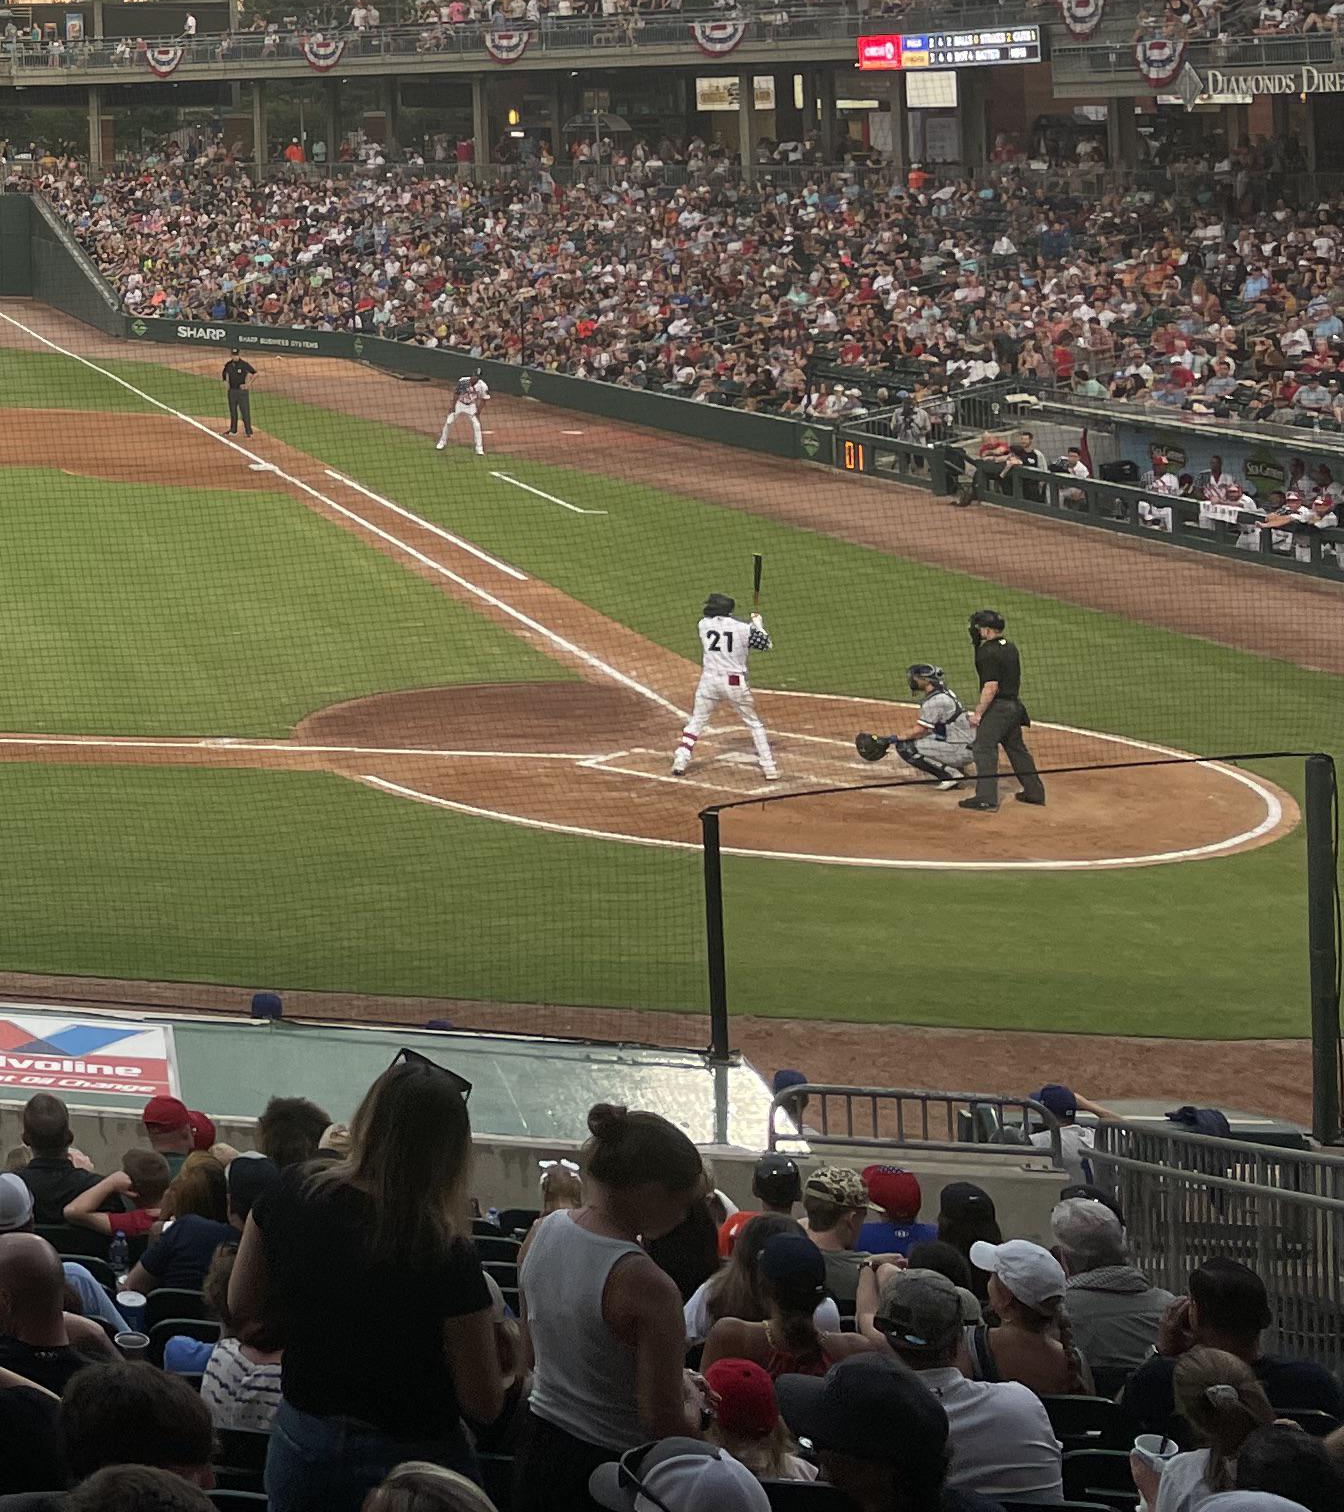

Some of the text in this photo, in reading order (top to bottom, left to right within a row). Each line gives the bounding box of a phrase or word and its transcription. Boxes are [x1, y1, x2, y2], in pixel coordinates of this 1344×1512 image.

[1208, 70, 1296, 95] DIAMONDS
[177, 326, 226, 340] SHARP
[706, 629, 734, 653] 21
[20, 1074, 55, 1086] Oil
[56, 1077, 157, 1094] Change
